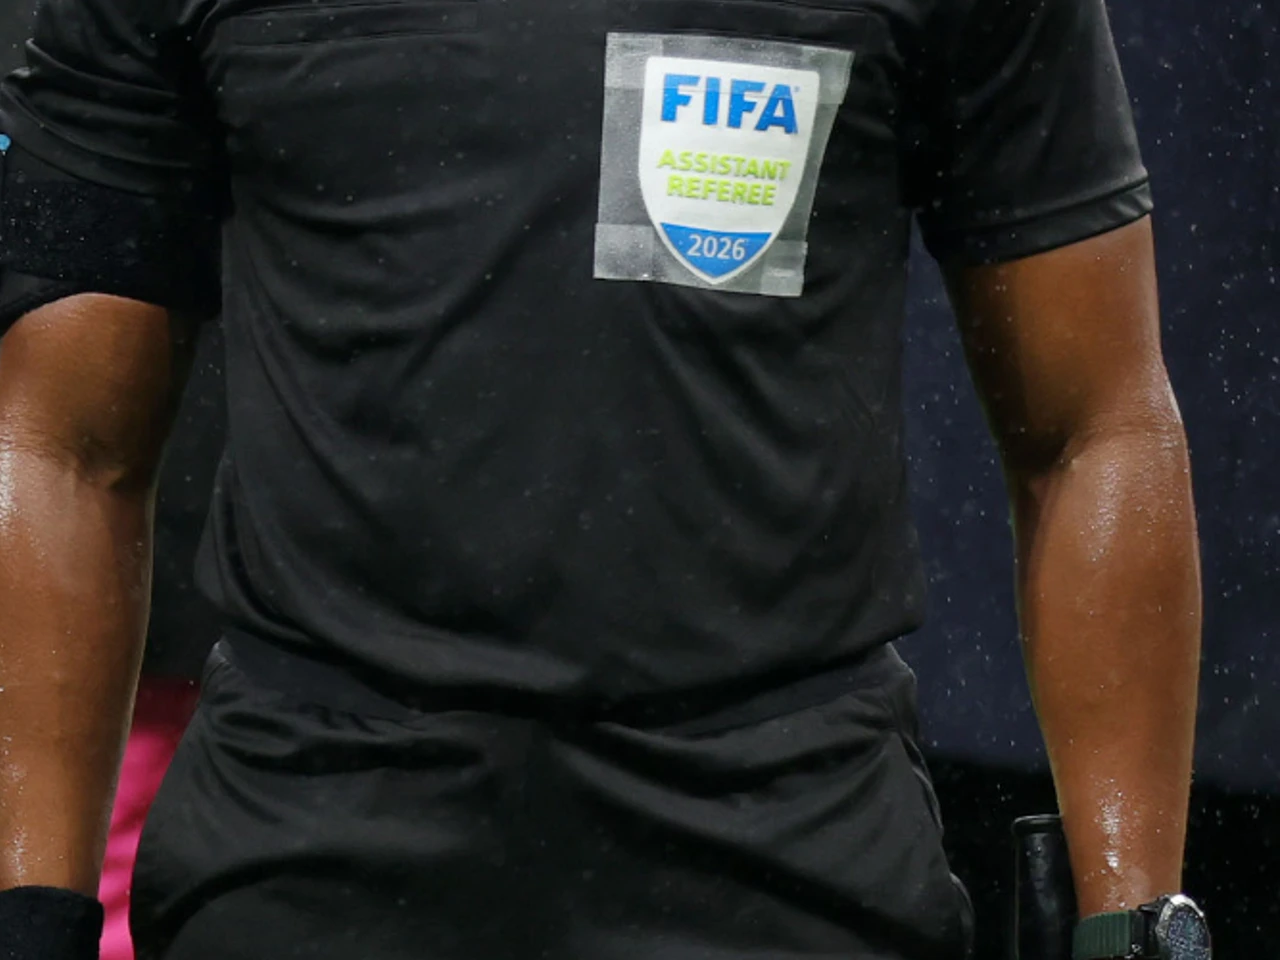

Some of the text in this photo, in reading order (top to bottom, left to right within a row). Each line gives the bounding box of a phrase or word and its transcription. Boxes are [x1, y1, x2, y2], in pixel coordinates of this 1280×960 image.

[661, 73, 798, 134] FIFA
[656, 149, 792, 181] ASSISTANT
[667, 174, 776, 206] REFEREE
[687, 234, 745, 260] 2026
